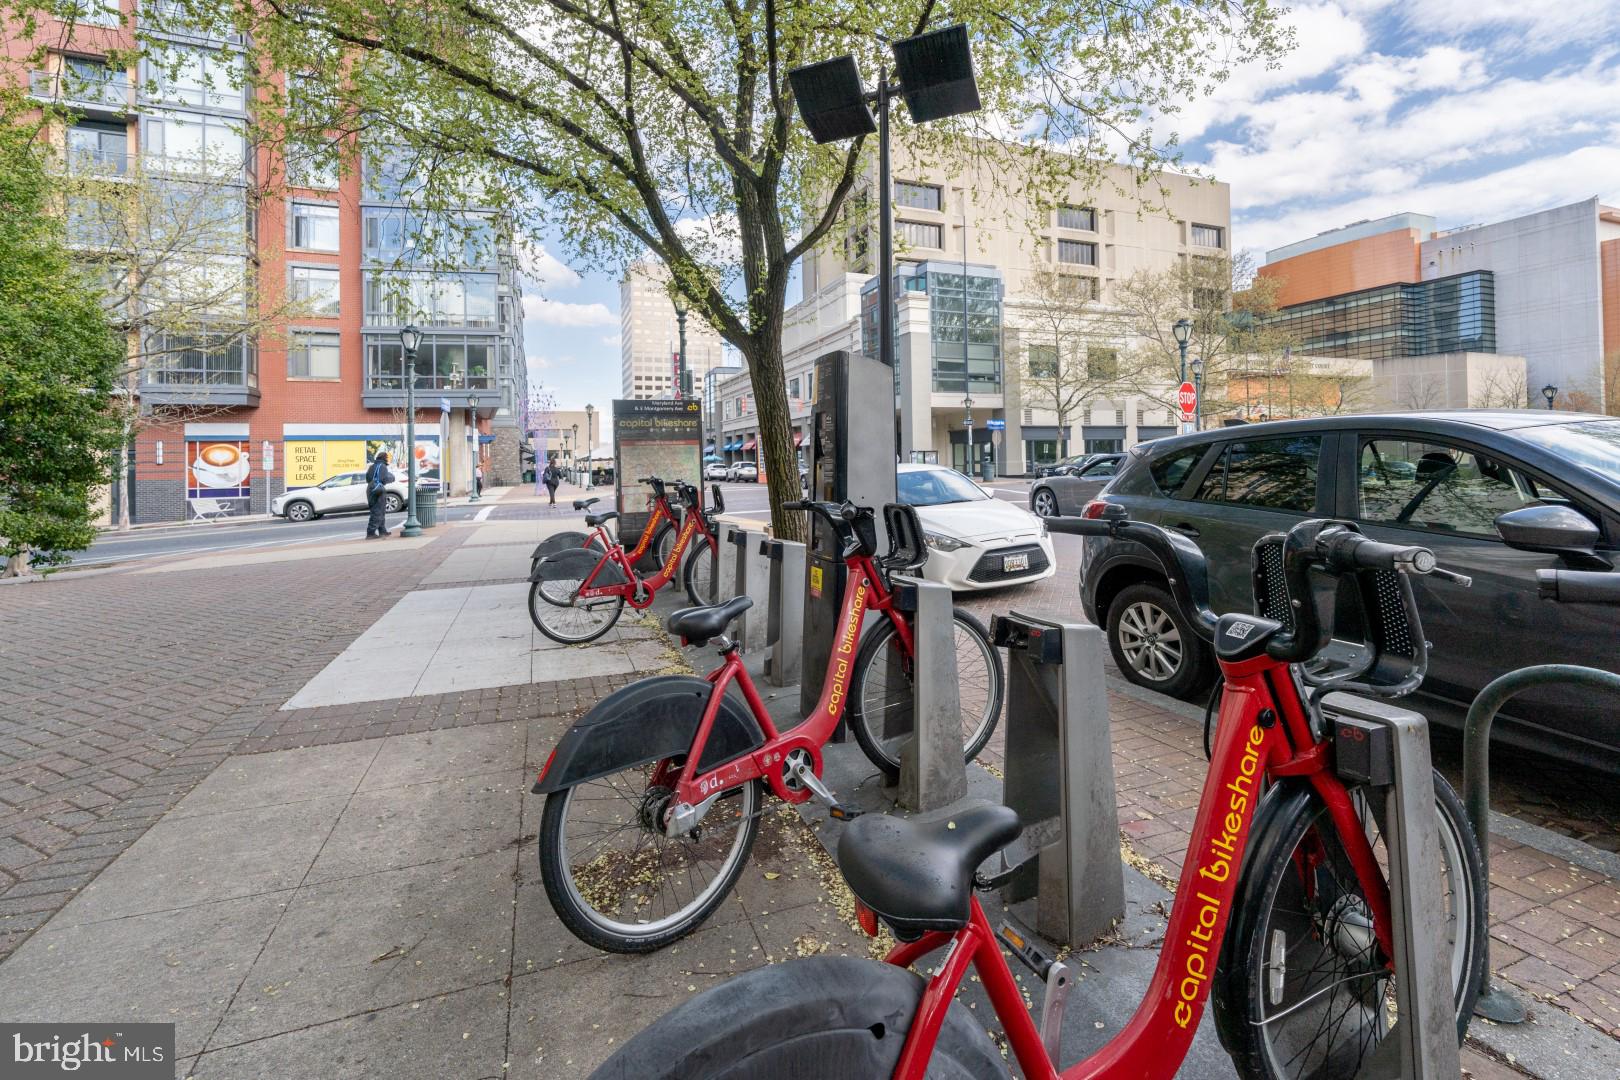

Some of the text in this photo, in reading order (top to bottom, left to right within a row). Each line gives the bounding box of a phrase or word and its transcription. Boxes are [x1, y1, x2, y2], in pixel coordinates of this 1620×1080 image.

[1180, 391, 1196, 405] STOP
[619, 416, 698, 428] capital bikeshare
[294, 446, 318, 454] RETAIL
[295, 455, 317, 463] SPACE
[295, 473, 317, 481] LEASE
[663, 521, 694, 578] capital bikeshare
[828, 586, 866, 716] capital bikeshare
[1174, 725, 1265, 1029] capital bikeshare
